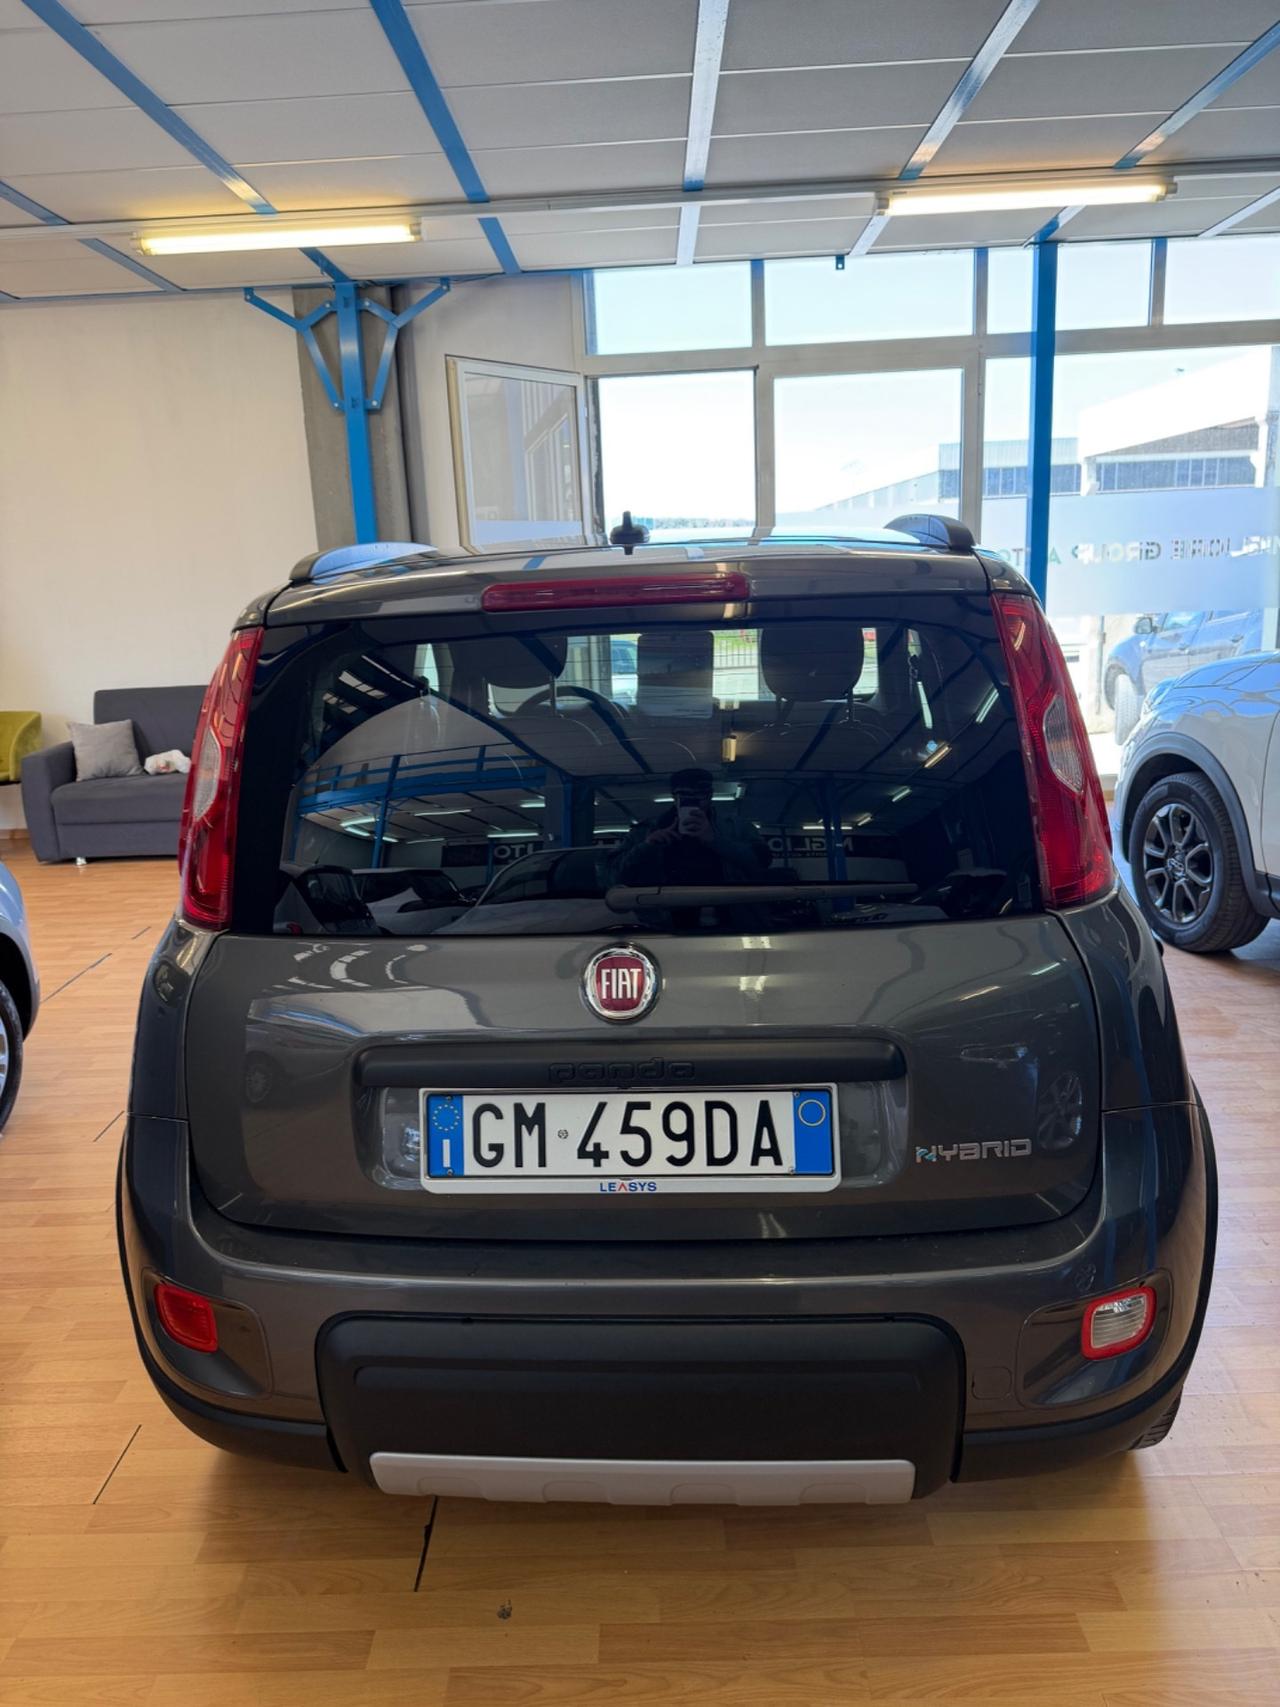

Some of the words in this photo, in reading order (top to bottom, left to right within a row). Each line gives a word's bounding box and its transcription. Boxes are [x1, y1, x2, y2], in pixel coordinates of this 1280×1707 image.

[601, 967, 642, 1000] FIAT
[548, 1057, 696, 1084] panda
[472, 1102, 547, 1169] GM
[576, 1100, 784, 1168] 459DA
[914, 1138, 1033, 1164] HYBRID
[600, 1181, 658, 1193] LEASYS
